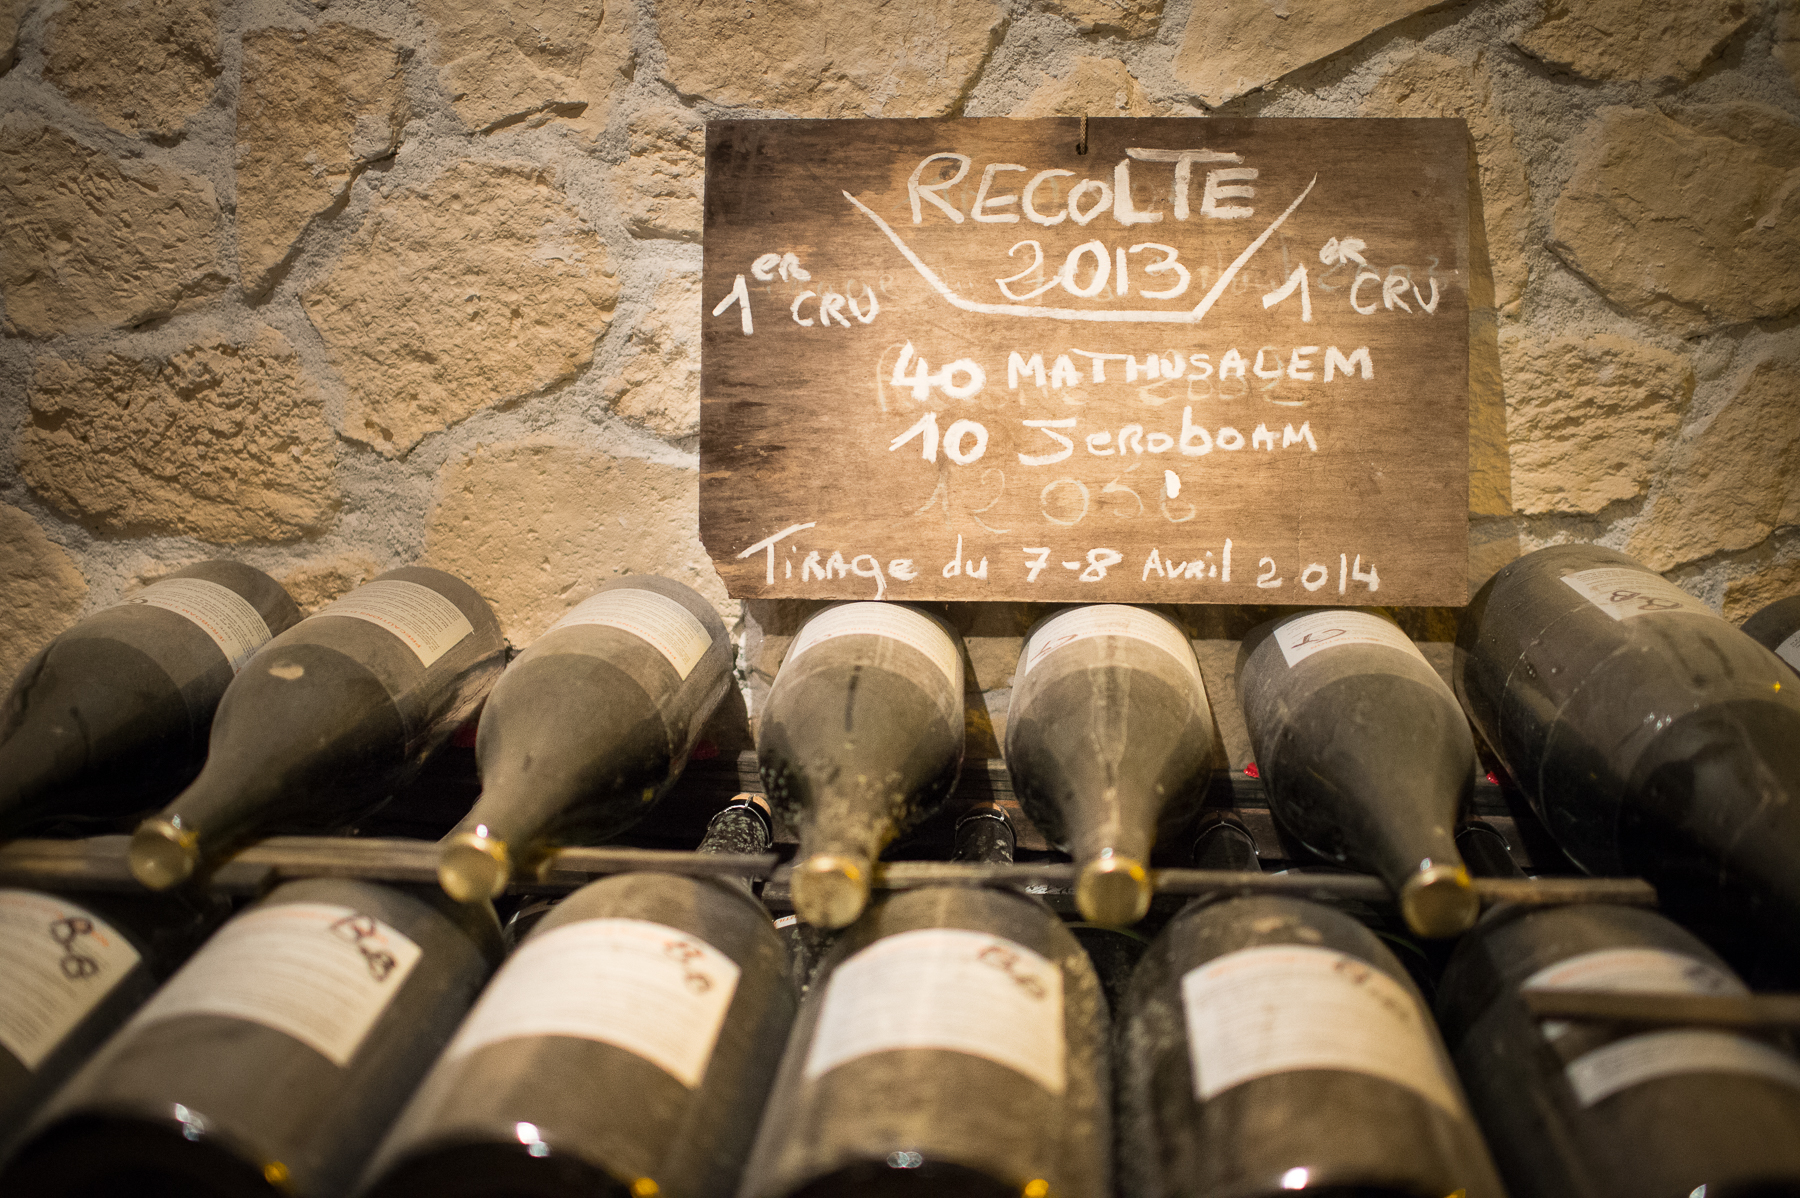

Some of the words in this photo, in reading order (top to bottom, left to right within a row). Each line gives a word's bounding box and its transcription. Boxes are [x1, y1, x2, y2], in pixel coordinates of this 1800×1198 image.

[908, 148, 1258, 226] RECOLTE
[995, 240, 1191, 301] 2013
[1349, 272, 1440, 315] CRU
[790, 287, 880, 328] CRU
[891, 341, 987, 401] 40
[1008, 346, 1375, 389] MATHUSALEM
[889, 412, 989, 465] 10
[942, 533, 988, 579] du
